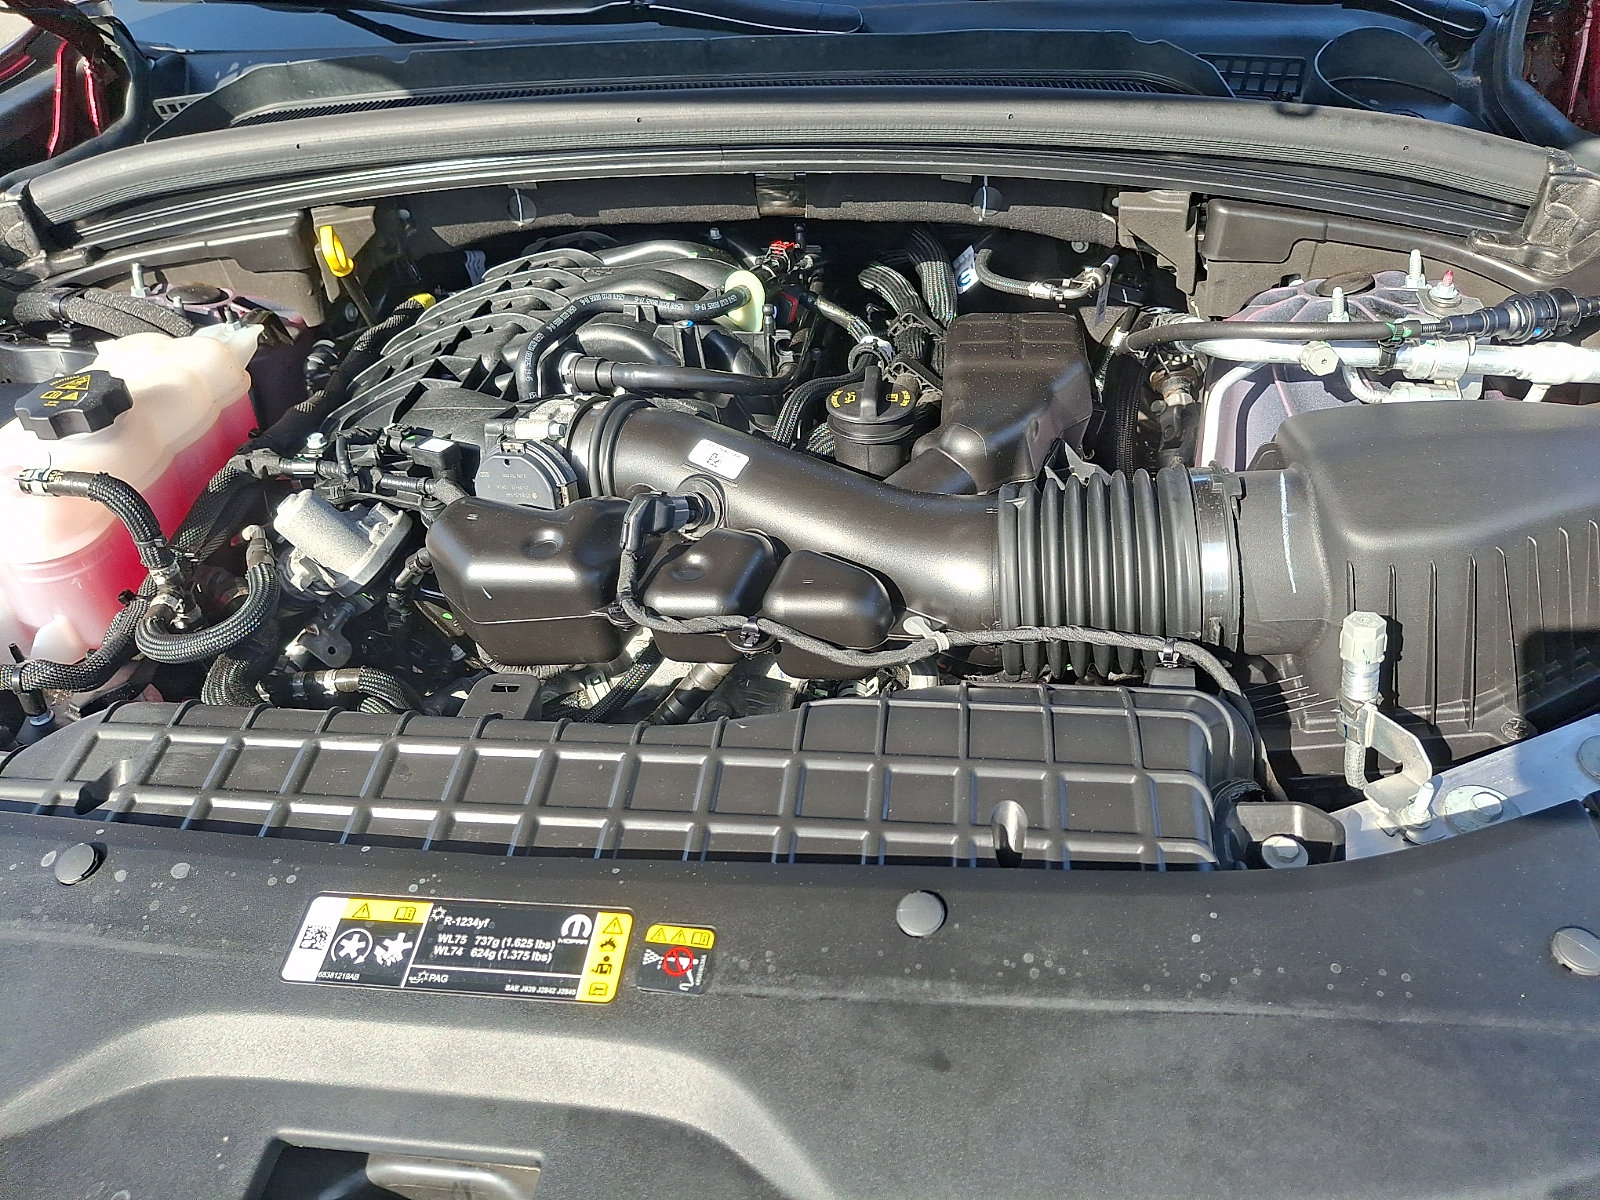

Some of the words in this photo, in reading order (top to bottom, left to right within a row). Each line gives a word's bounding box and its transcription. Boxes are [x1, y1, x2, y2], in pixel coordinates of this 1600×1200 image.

[443, 915, 490, 929] R-1234yf
[437, 933, 467, 944] WL75
[474, 935, 499, 948] 737g
[501, 936, 533, 948] (1.625
[534, 938, 555, 951] lbs)
[433, 945, 463, 956] WL74
[470, 947, 496, 960] 624g
[497, 949, 530, 960] (1.375
[531, 951, 552, 964] lbs)
[428, 974, 448, 983] PAG
